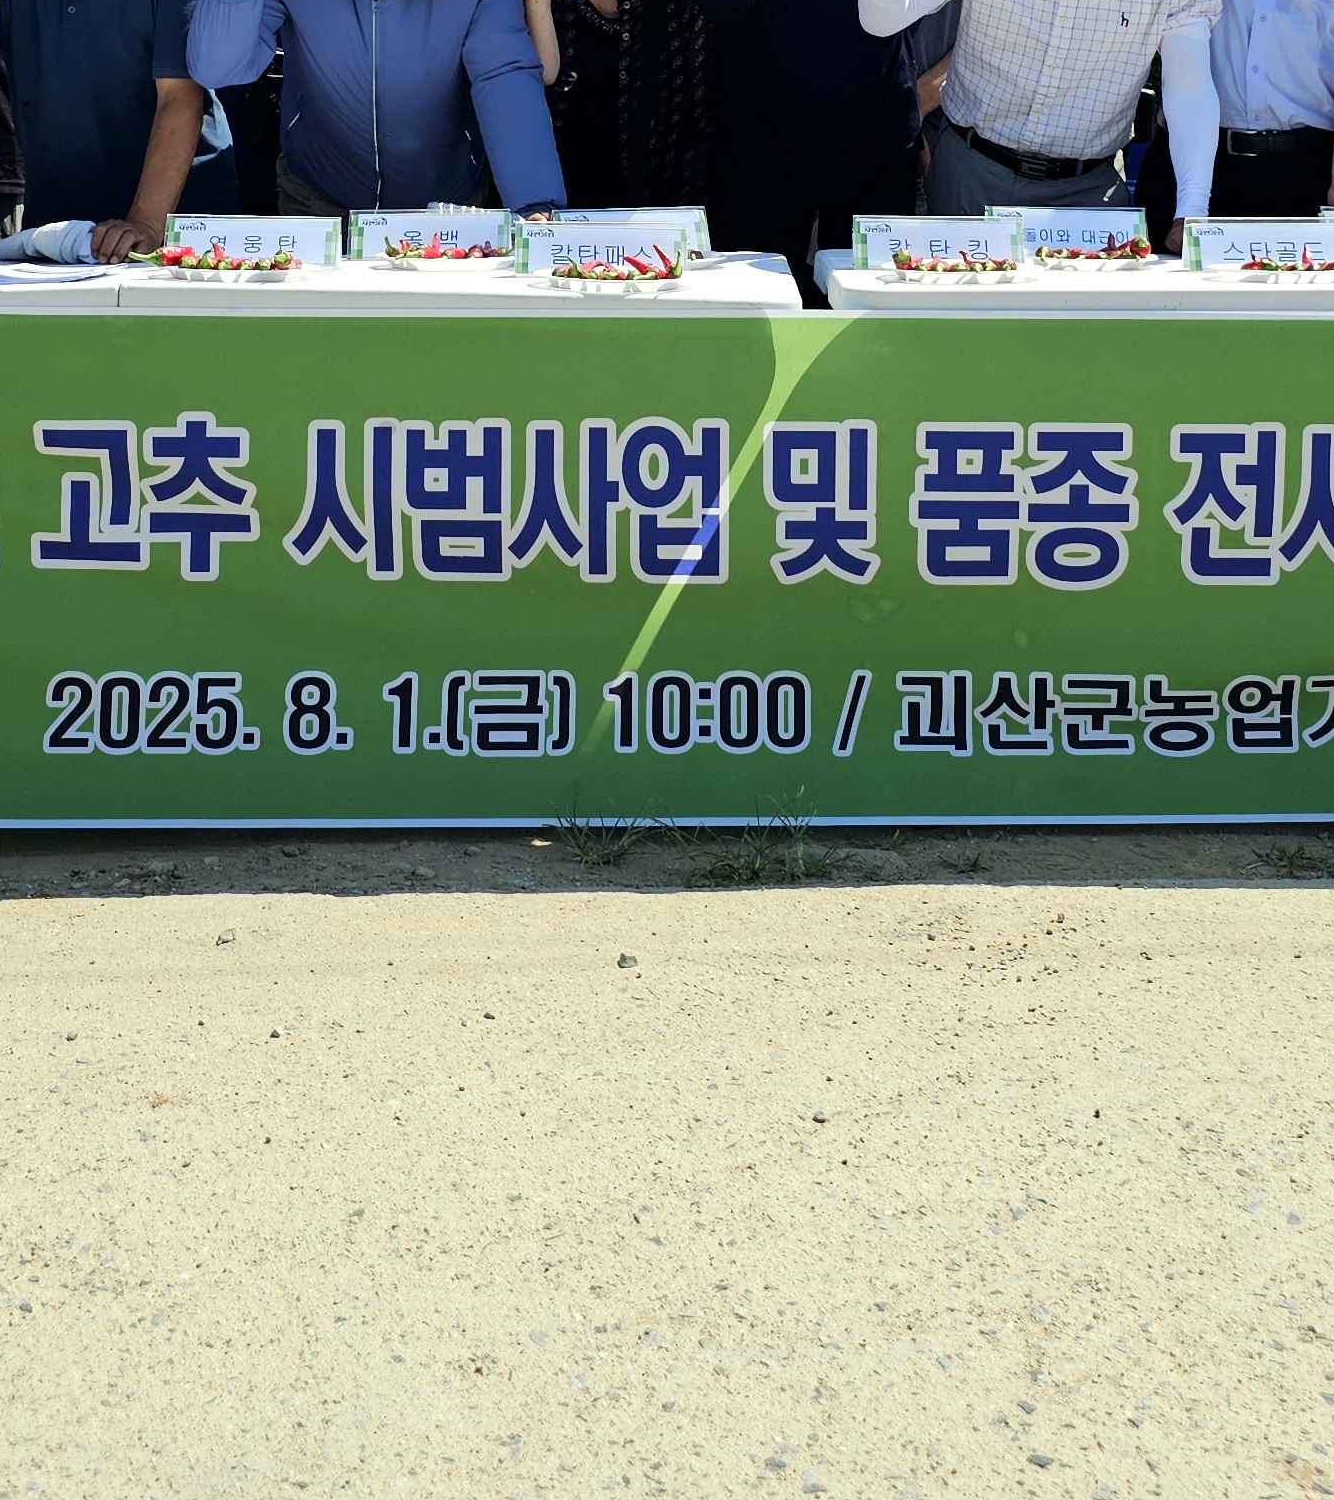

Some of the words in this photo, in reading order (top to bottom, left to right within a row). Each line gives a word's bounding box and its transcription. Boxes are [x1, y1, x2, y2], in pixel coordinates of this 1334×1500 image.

[33, 417, 257, 576] 고추
[289, 417, 726, 580] 시범사업
[769, 425, 876, 580] 및
[915, 423, 1137, 586] 품종
[47, 674, 257, 753] 2025.
[284, 674, 352, 752] 8.
[385, 673, 573, 753] 1.(금)
[606, 675, 805, 753] 10:00
